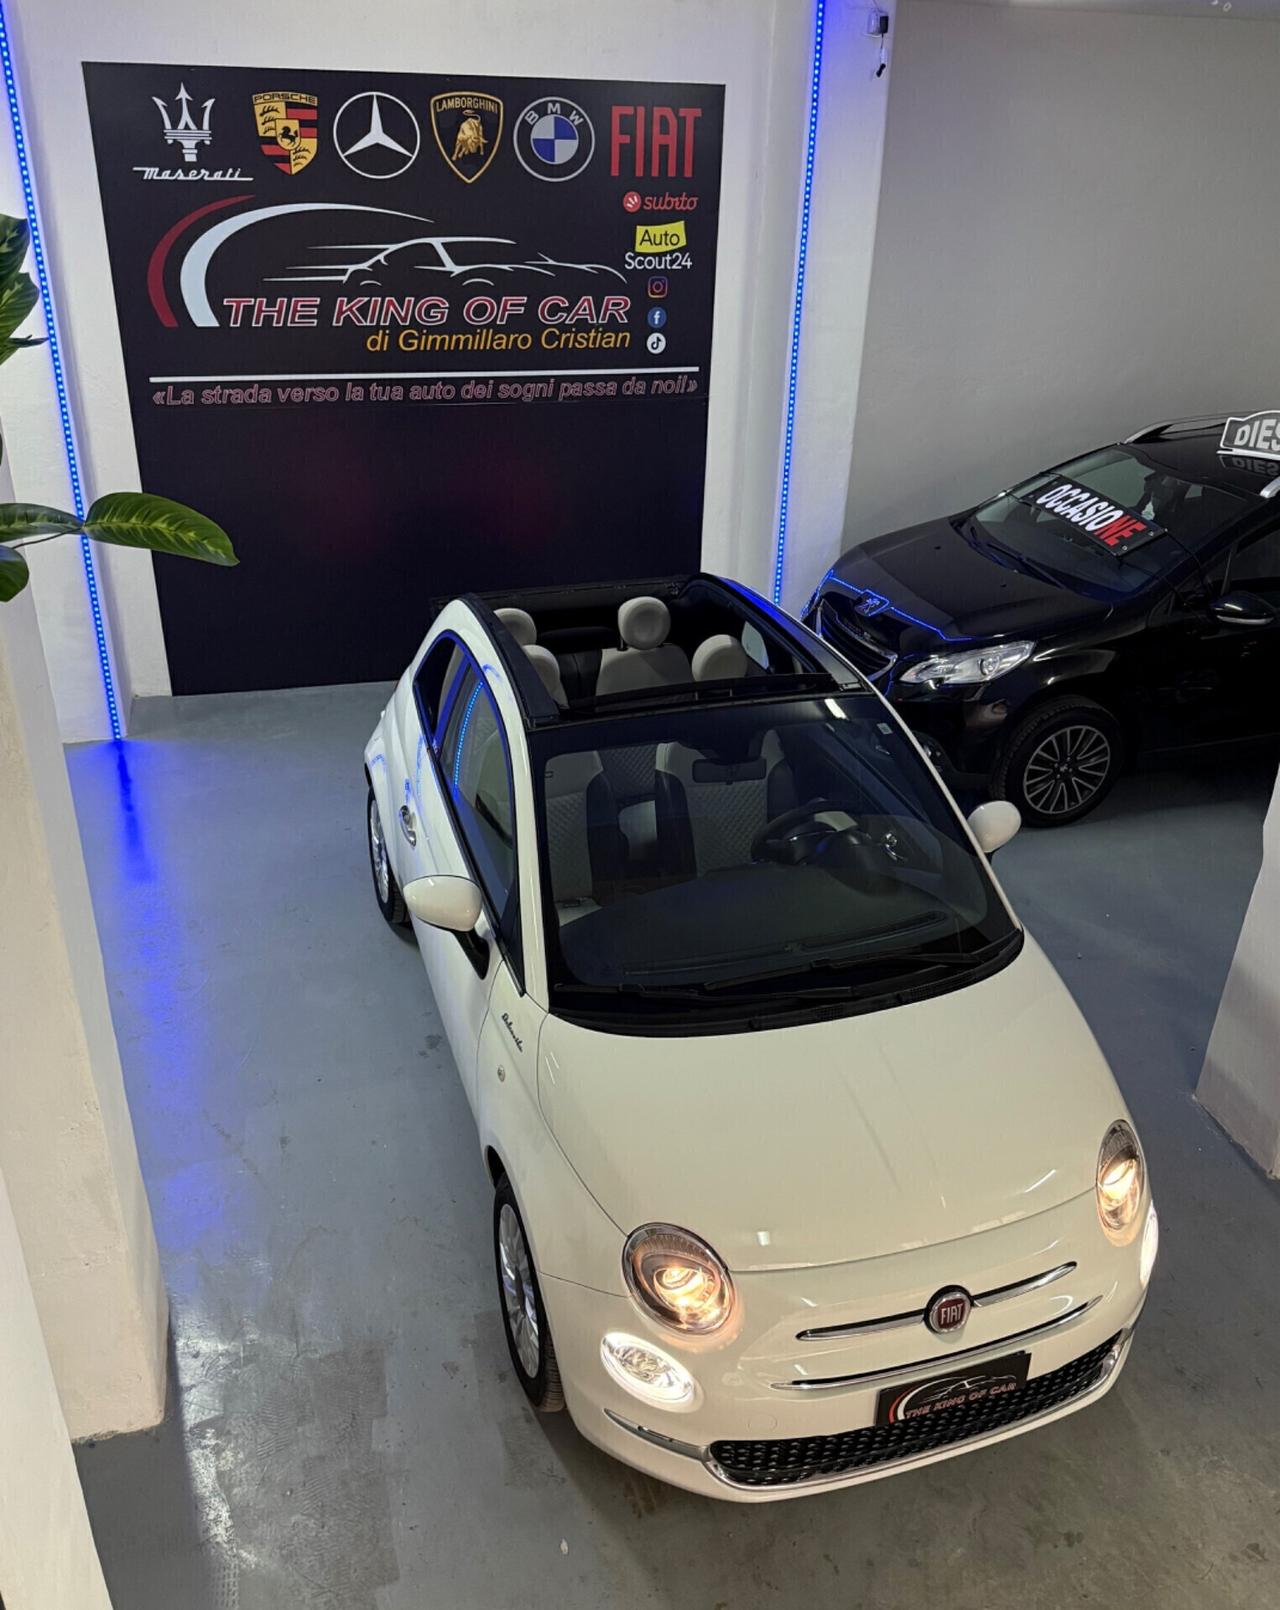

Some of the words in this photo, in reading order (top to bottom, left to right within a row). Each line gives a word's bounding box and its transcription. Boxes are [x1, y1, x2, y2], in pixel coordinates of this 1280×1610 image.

[254, 92, 316, 105] PORSCHE
[436, 97, 499, 114] LAMBORGHINI
[524, 102, 585, 126] BMW
[610, 105, 702, 178] FIAT
[132, 166, 254, 181] Maserati
[640, 228, 680, 247] Auto
[624, 252, 693, 270] Scout24
[223, 297, 321, 327] THE
[332, 296, 450, 327] KING
[463, 296, 528, 325] OF
[538, 295, 631, 325] CAR
[366, 329, 389, 352] di
[398, 329, 532, 352] Gimmillaro
[541, 327, 631, 350] Cristian
[152, 385, 195, 406] «La
[201, 384, 272, 405] strada
[277, 386, 340, 404] verso
[345, 382, 364, 401] la
[369, 381, 404, 401] tua
[409, 380, 456, 401] auto
[460, 379, 494, 399] dei
[498, 379, 555, 402] sogni
[558, 381, 617, 401] passa
[622, 376, 646, 395] da
[1036, 484, 1147, 547] OCCASIONE
[941, 1303, 963, 1324] FIAT
